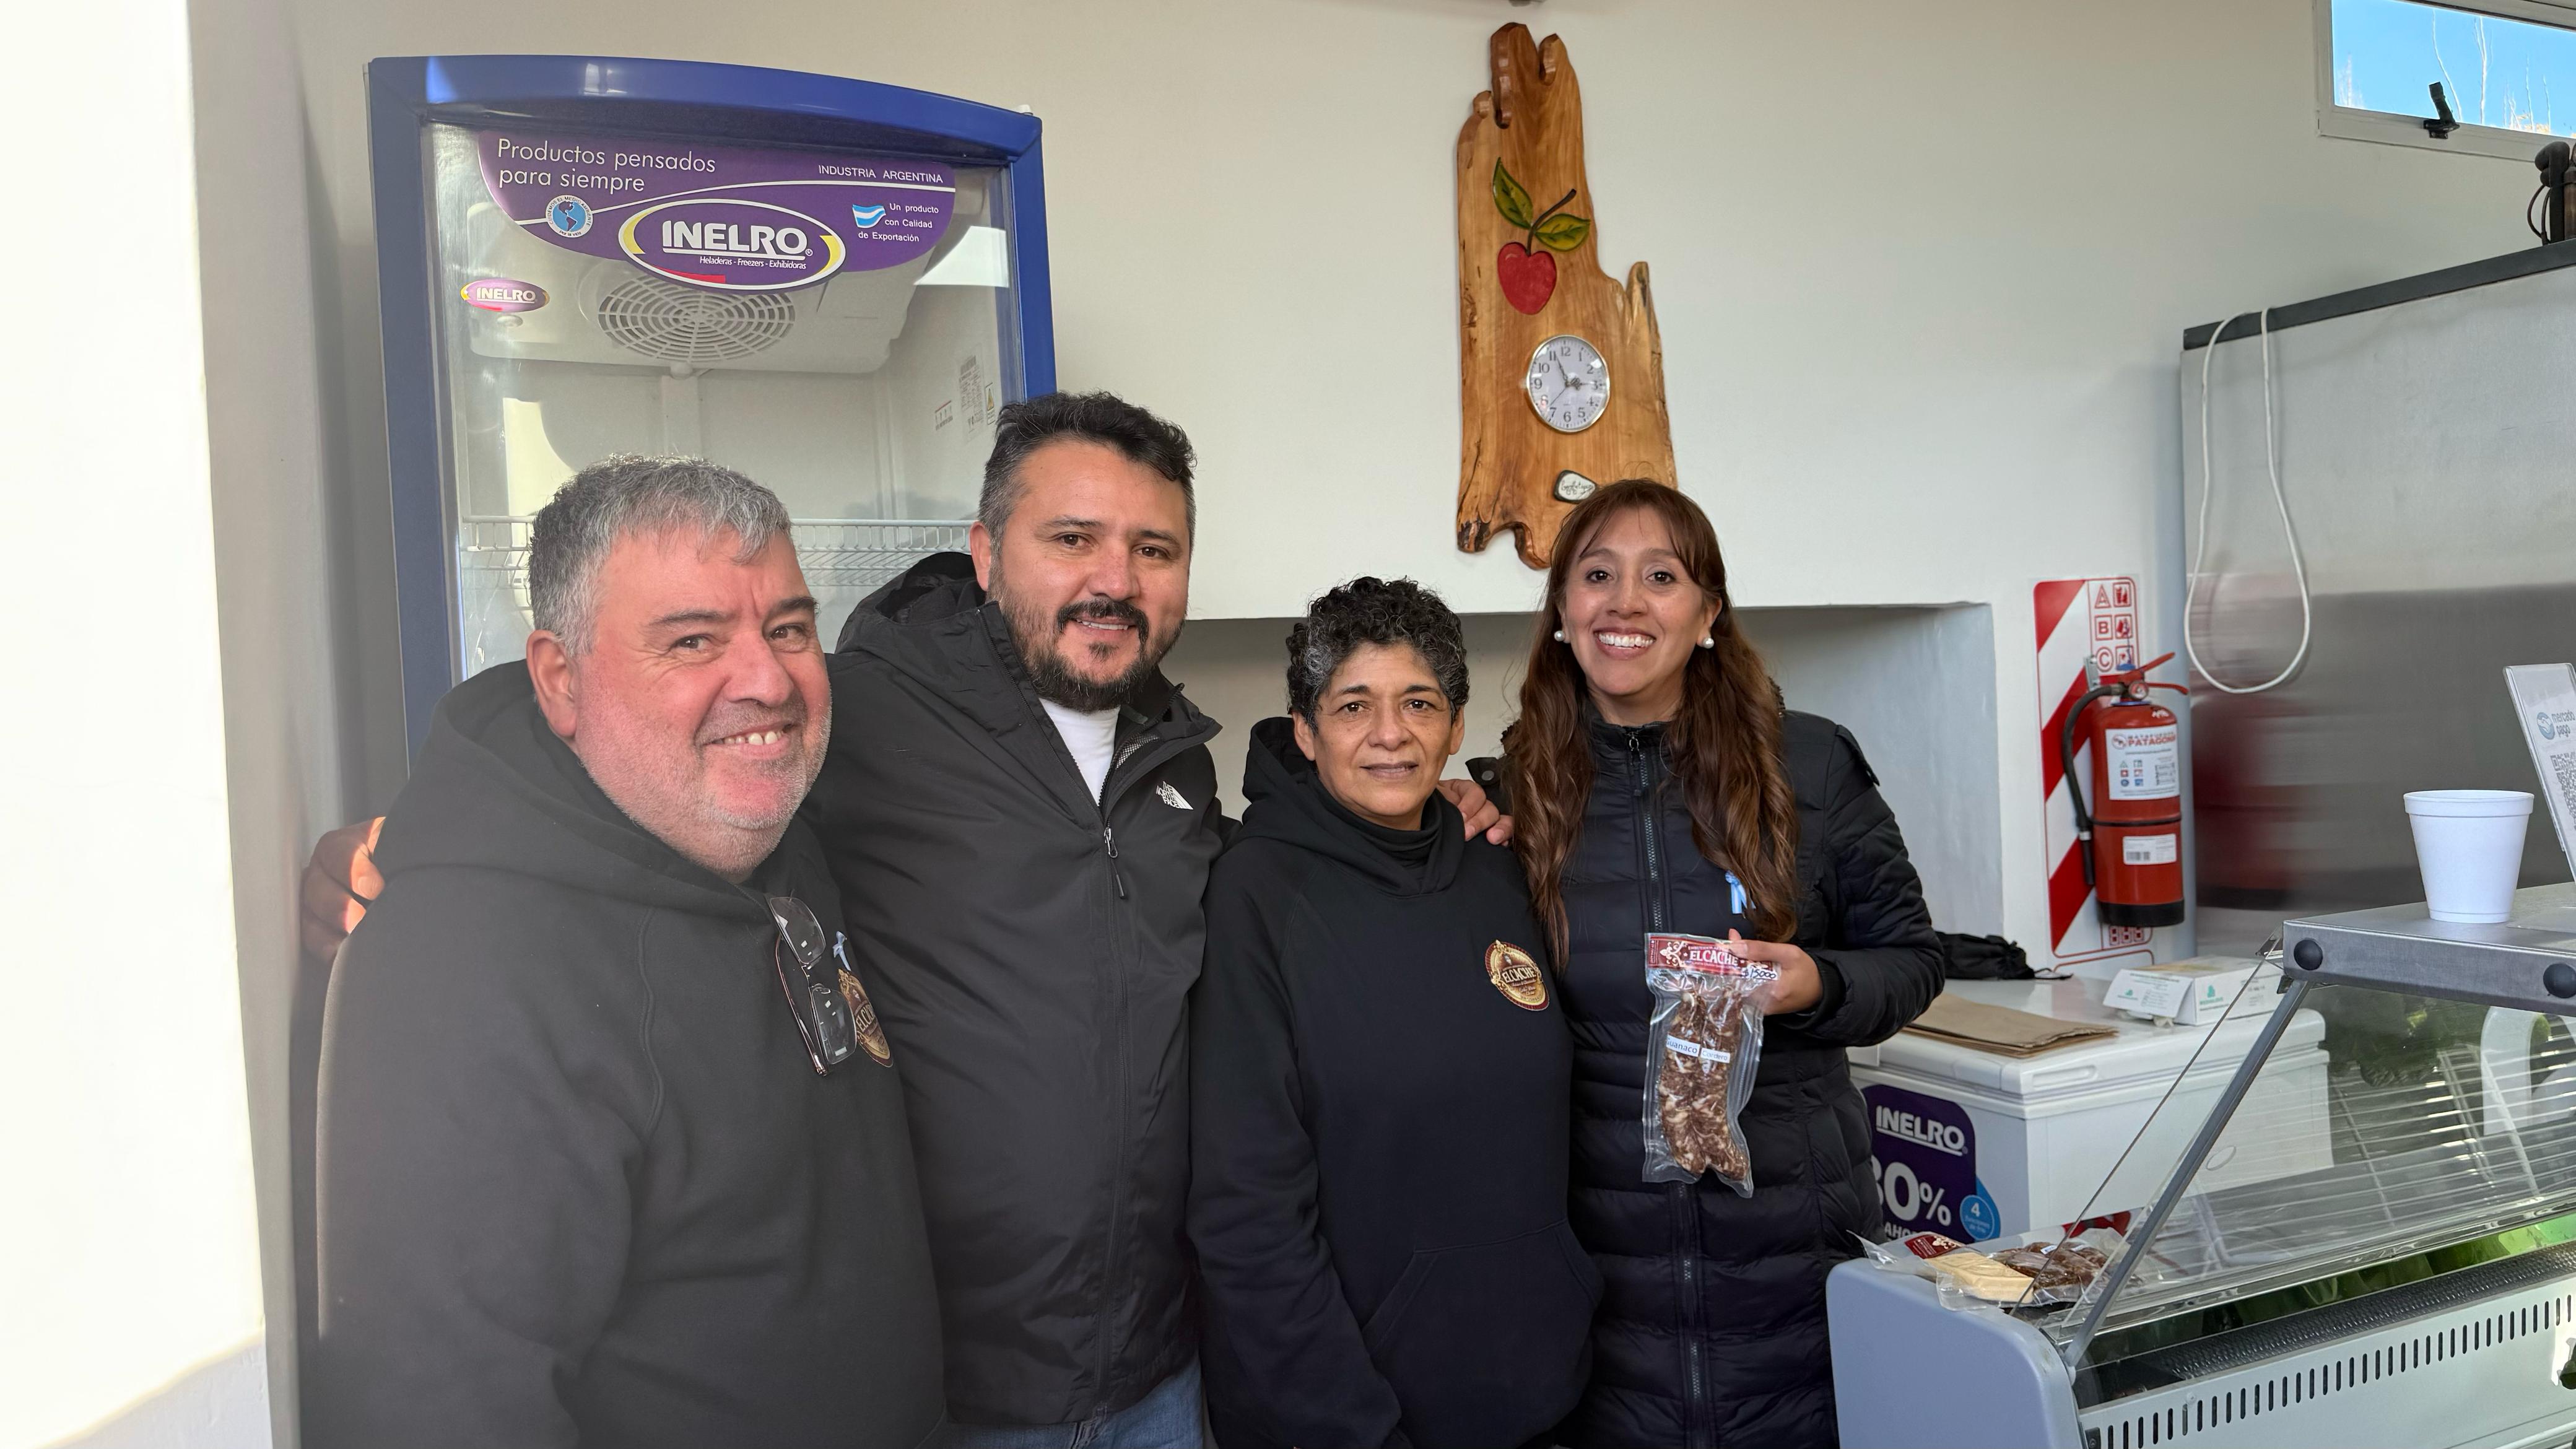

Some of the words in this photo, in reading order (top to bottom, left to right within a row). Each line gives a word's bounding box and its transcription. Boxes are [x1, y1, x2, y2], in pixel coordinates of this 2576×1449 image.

[498, 137, 606, 165] Productos
[614, 150, 716, 173] pensados
[818, 165, 876, 178] INDUSTRIA
[883, 170, 944, 183] ARGENTINA
[499, 168, 552, 188] para
[560, 168, 645, 194] siempre
[889, 202, 901, 211] Un
[905, 204, 939, 214] producto
[902, 219, 933, 228] Calidad
[662, 220, 807, 255] INELRO
[858, 231, 868, 239] de
[872, 232, 920, 242] Exportación
[699, 256, 733, 266] Heladeras
[738, 258, 764, 268] Freezers
[769, 260, 806, 270] Exhibidoras
[476, 287, 536, 302] INELRO
[1549, 350, 1556, 361] 11
[1560, 347, 1571, 357] 12
[1579, 351, 1582, 362] 1
[1539, 363, 1550, 373] 10
[1586, 363, 1594, 374] 2
[1534, 378, 1543, 389] 9
[1549, 407, 1557, 418] 7
[1563, 411, 1572, 422] 6
[1578, 407, 1586, 418] 5
[2098, 621, 2109, 634] B
[2099, 651, 2110, 668] C
[1876, 1105, 1965, 1151] INELRO
[1971, 1202, 1980, 1217] 4
